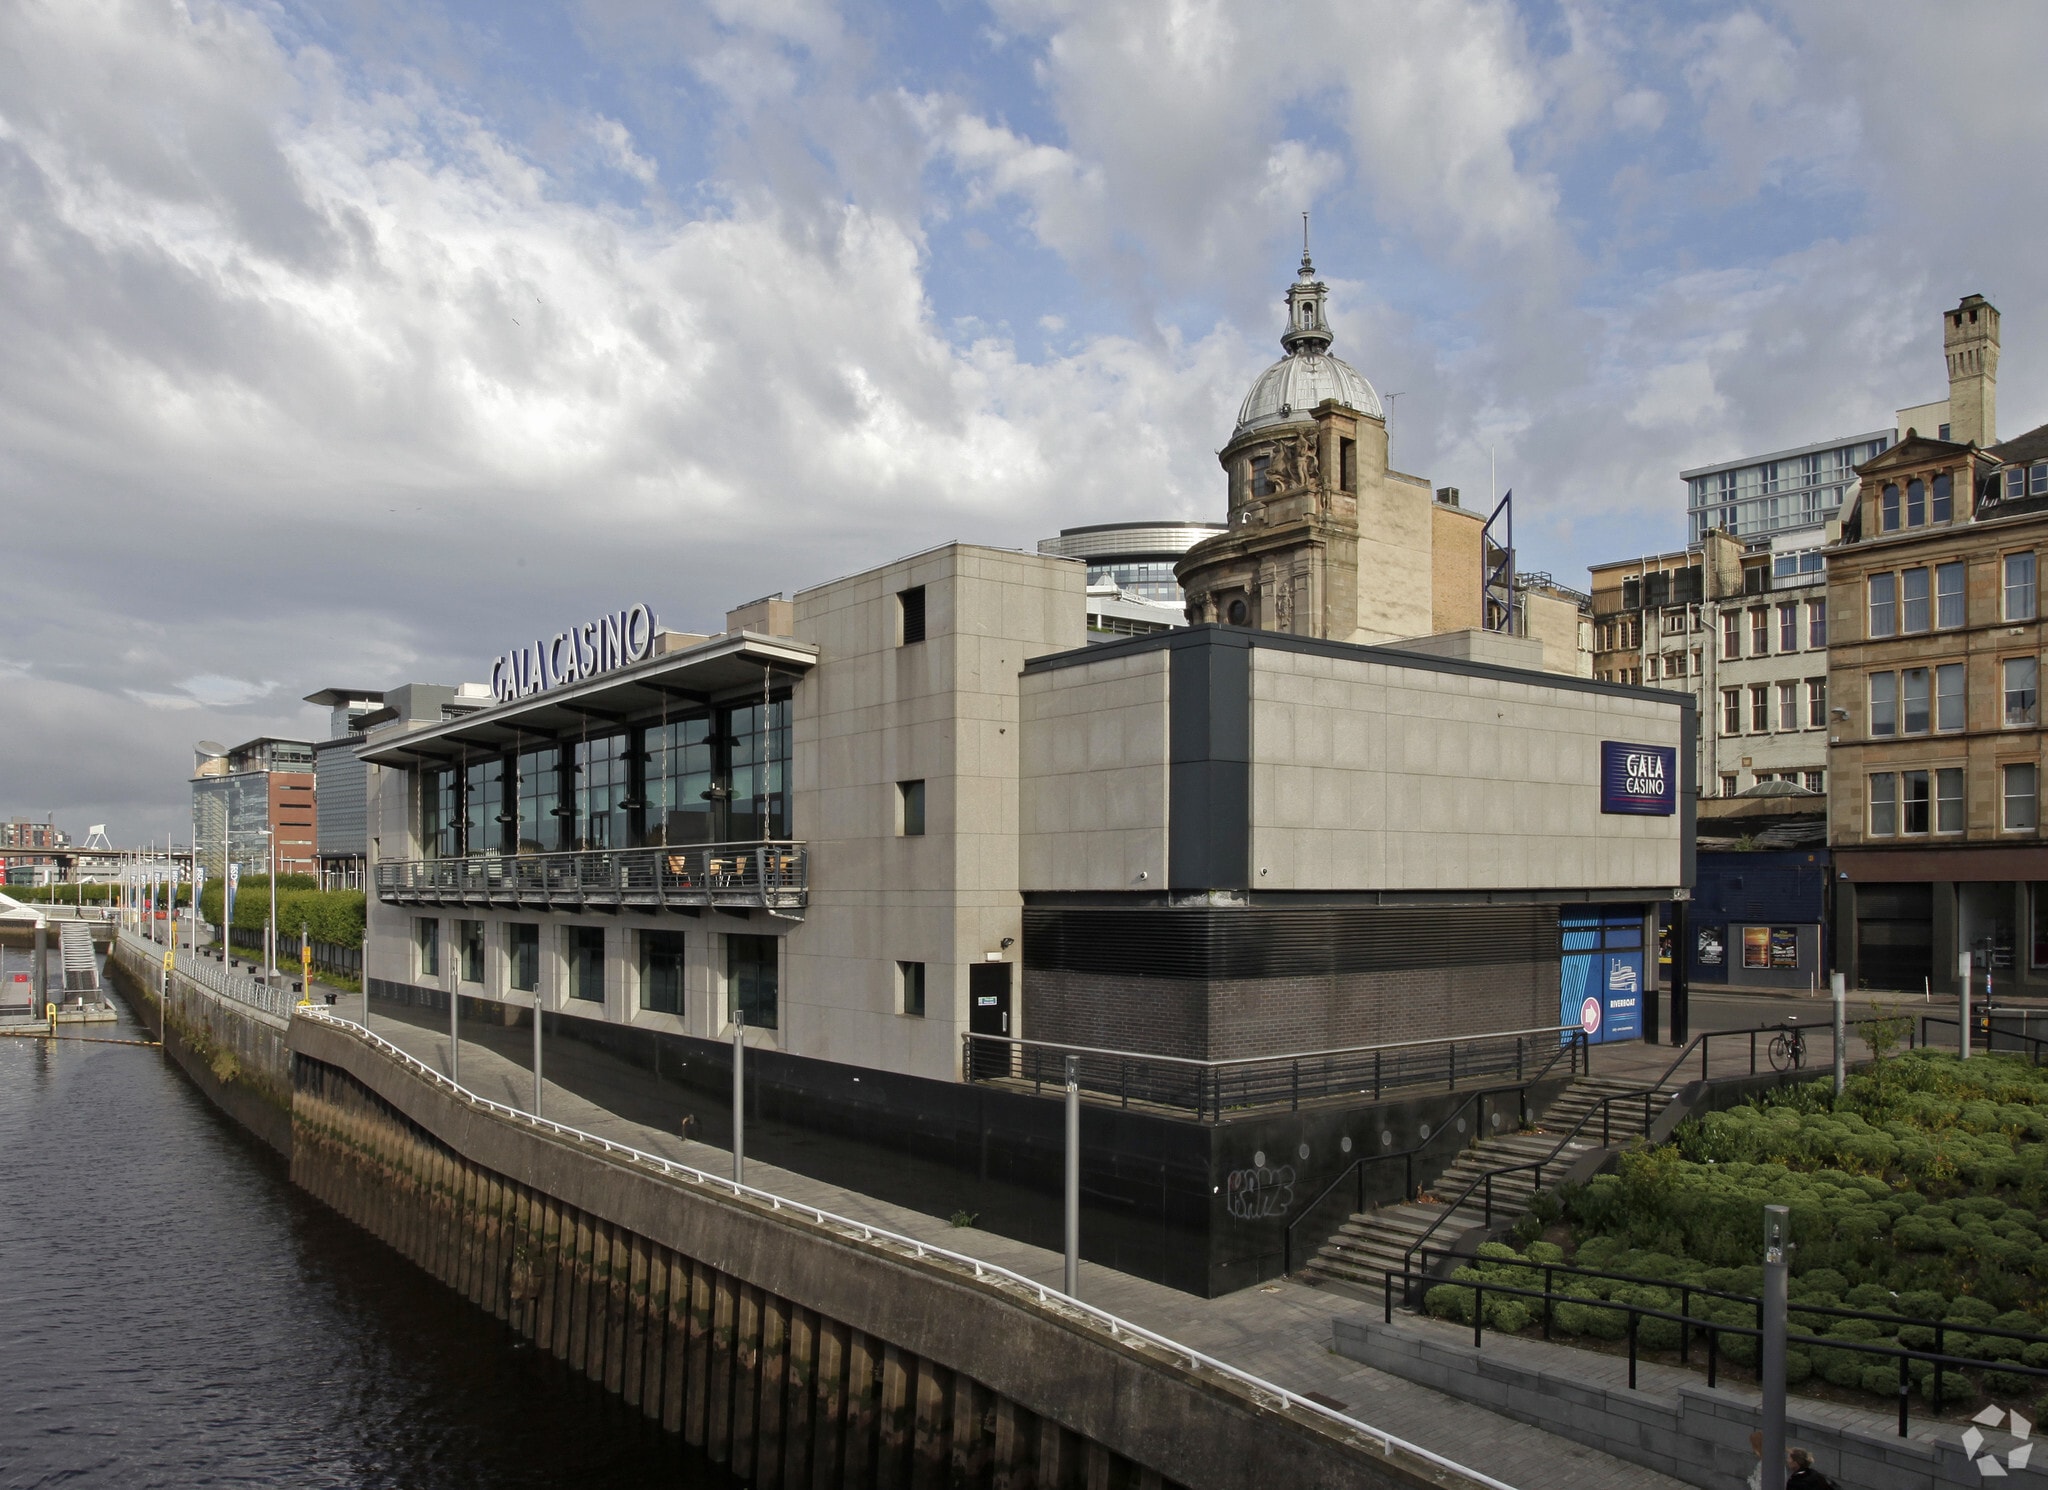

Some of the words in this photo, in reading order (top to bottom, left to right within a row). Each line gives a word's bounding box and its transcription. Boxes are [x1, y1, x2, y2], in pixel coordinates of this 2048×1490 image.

[490, 639, 548, 704] GALA
[550, 602, 655, 685] CASINO
[1627, 754, 1664, 778] GALA
[1626, 777, 1664, 795] CASINO
[1610, 998, 1636, 1009] RIVERBOAT
